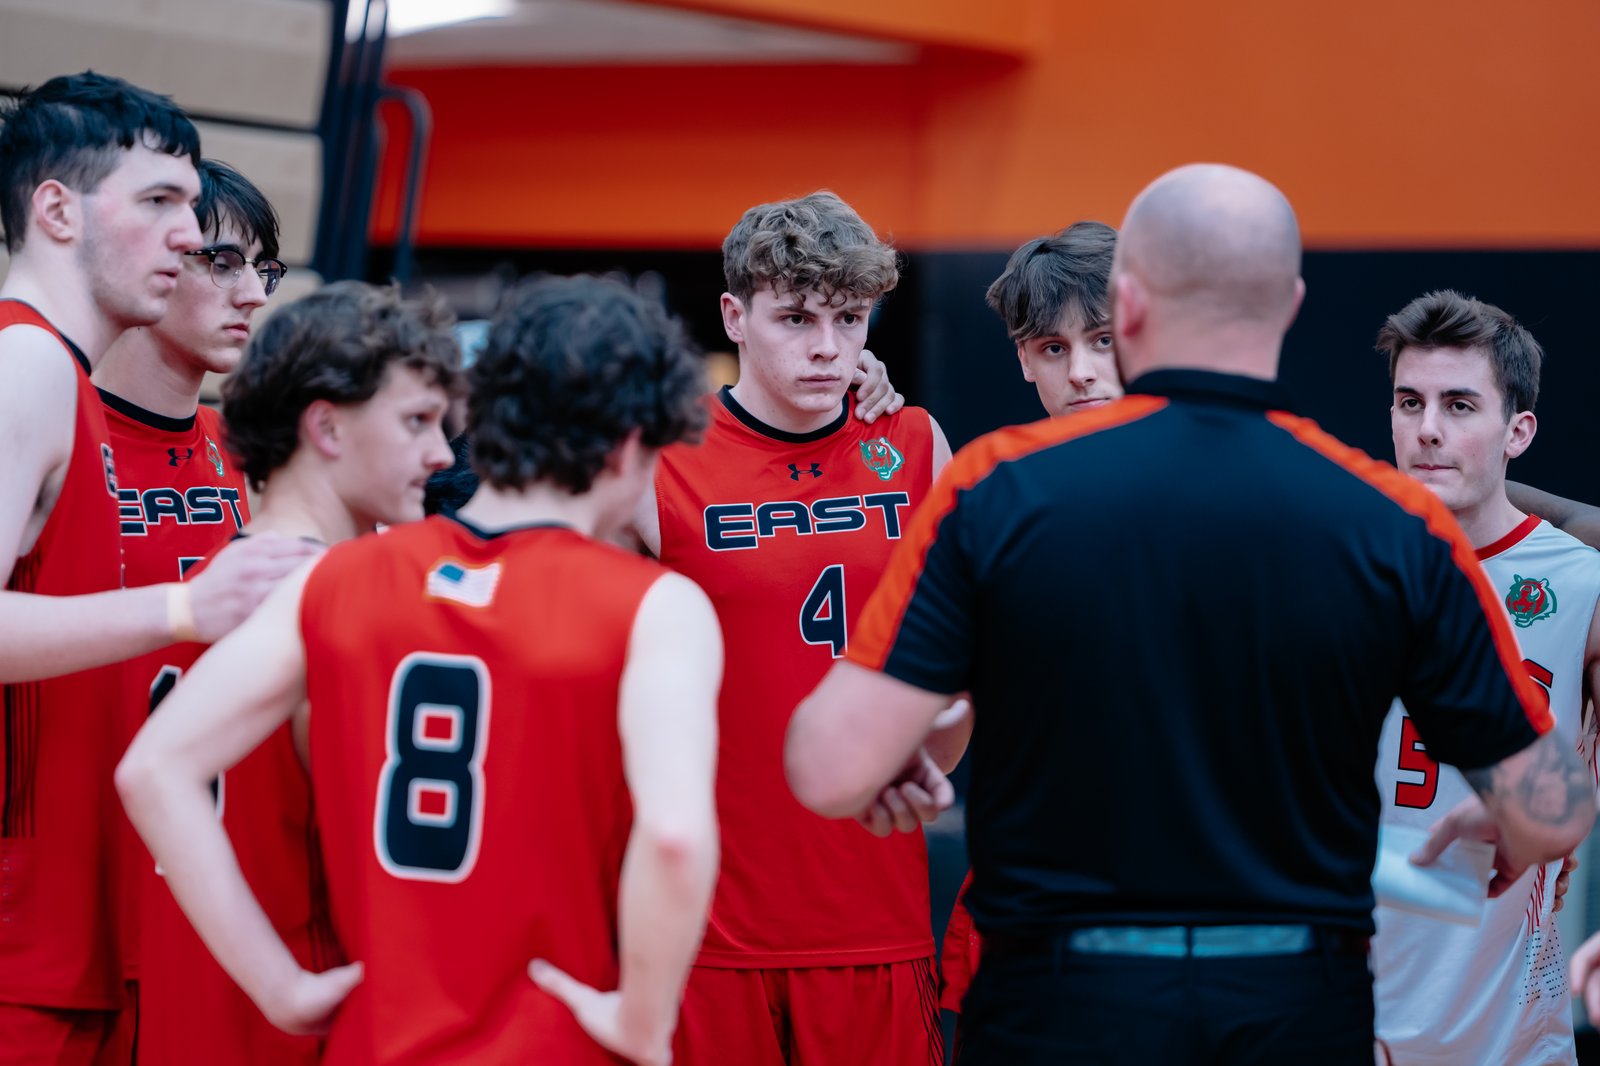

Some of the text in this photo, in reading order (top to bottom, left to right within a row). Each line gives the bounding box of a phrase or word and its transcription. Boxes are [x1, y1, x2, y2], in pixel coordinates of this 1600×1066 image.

[703, 491, 910, 552] EAST
[799, 564, 848, 659] 4
[373, 651, 492, 884] 8
